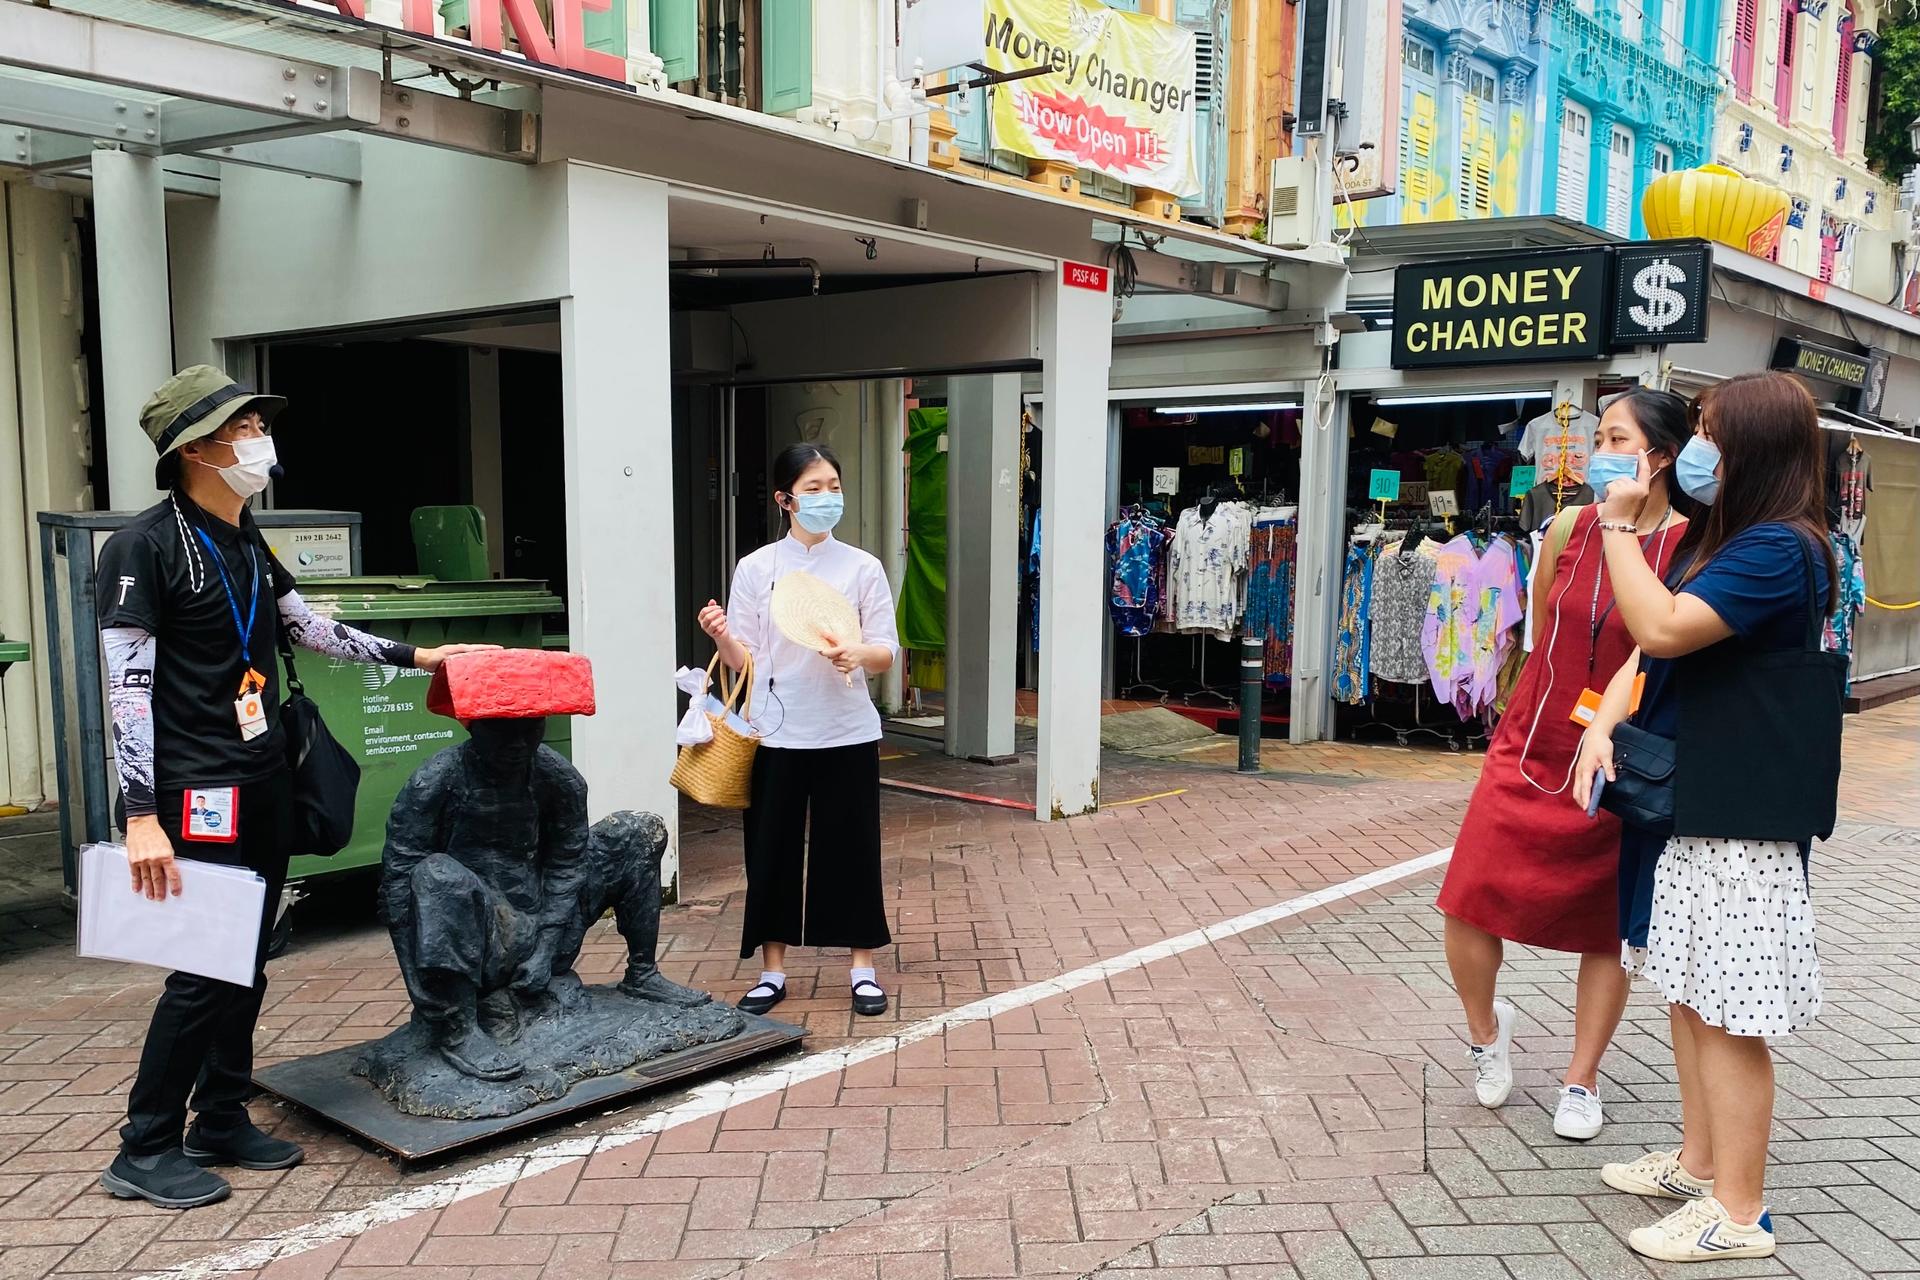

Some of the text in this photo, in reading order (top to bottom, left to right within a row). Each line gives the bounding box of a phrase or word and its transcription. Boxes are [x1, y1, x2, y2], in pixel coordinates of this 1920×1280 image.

[985, 12, 1079, 86] Money
[1085, 53, 1191, 114] Changer
[1022, 90, 1071, 136] Now
[1076, 112, 1127, 157] Open
[1362, 178, 1373, 187] ST
[1073, 269, 1099, 285] PSSF 46
[1421, 265, 1583, 311] MONEY
[1628, 258, 1688, 333] $
[1405, 311, 1587, 354] CHANGER
[1797, 349, 1866, 384] MONEY CHANGER
[1376, 477, 1391, 494] $10
[326, 533, 342, 541] 2642
[363, 694, 389, 703] Hotline
[363, 702, 414, 714] 1800-278 6135
[364, 725, 384, 735] Email
[365, 730, 453, 744] environment_contactus@
[365, 744, 417, 756] sembcorp.com
